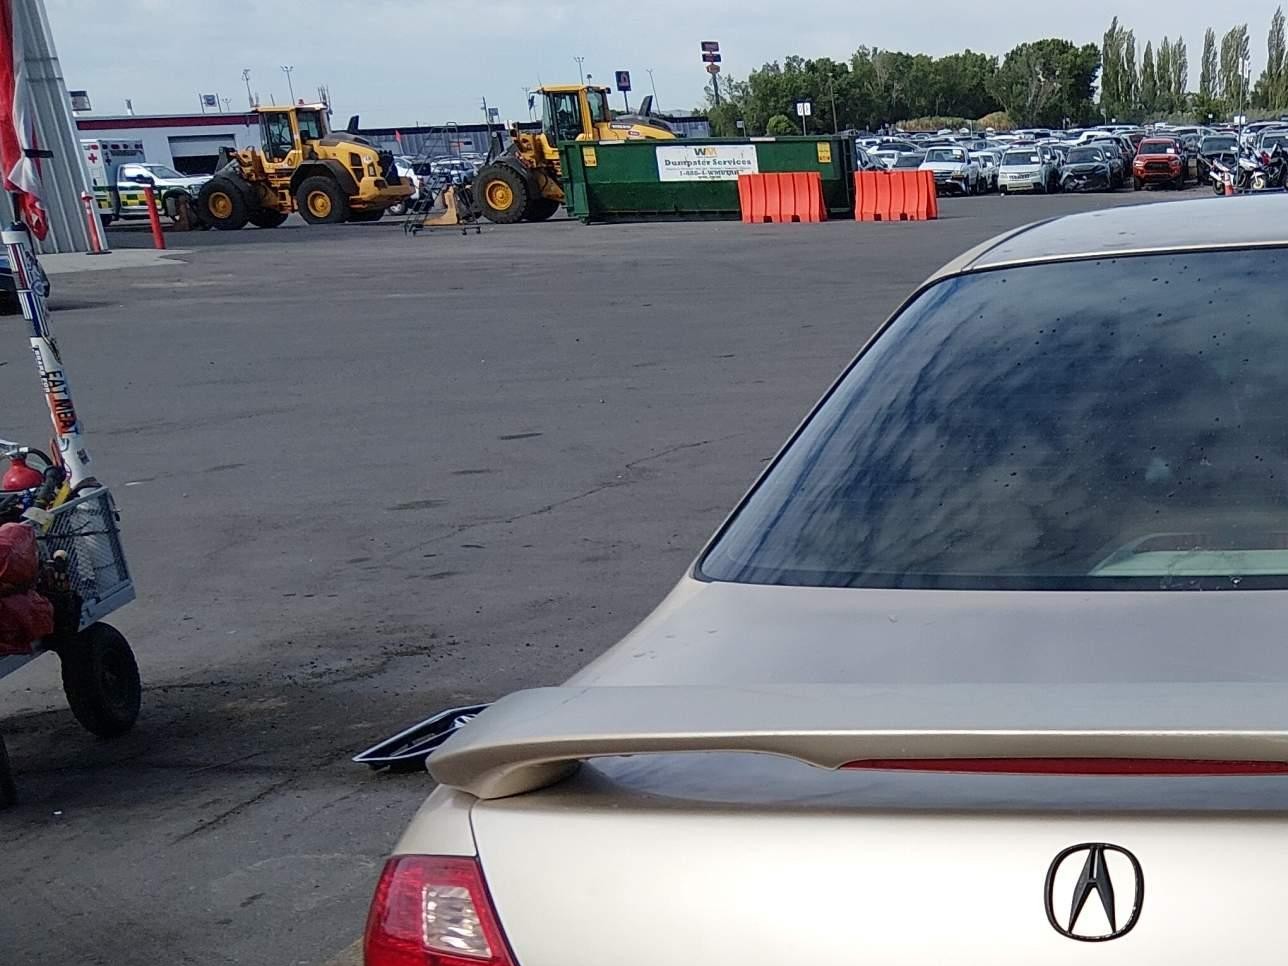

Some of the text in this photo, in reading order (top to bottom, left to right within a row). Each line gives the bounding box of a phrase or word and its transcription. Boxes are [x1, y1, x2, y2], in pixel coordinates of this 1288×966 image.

[694, 147, 718, 156] WM
[664, 159, 710, 167] Dumpster
[47, 370, 79, 434] EAT MEAT
